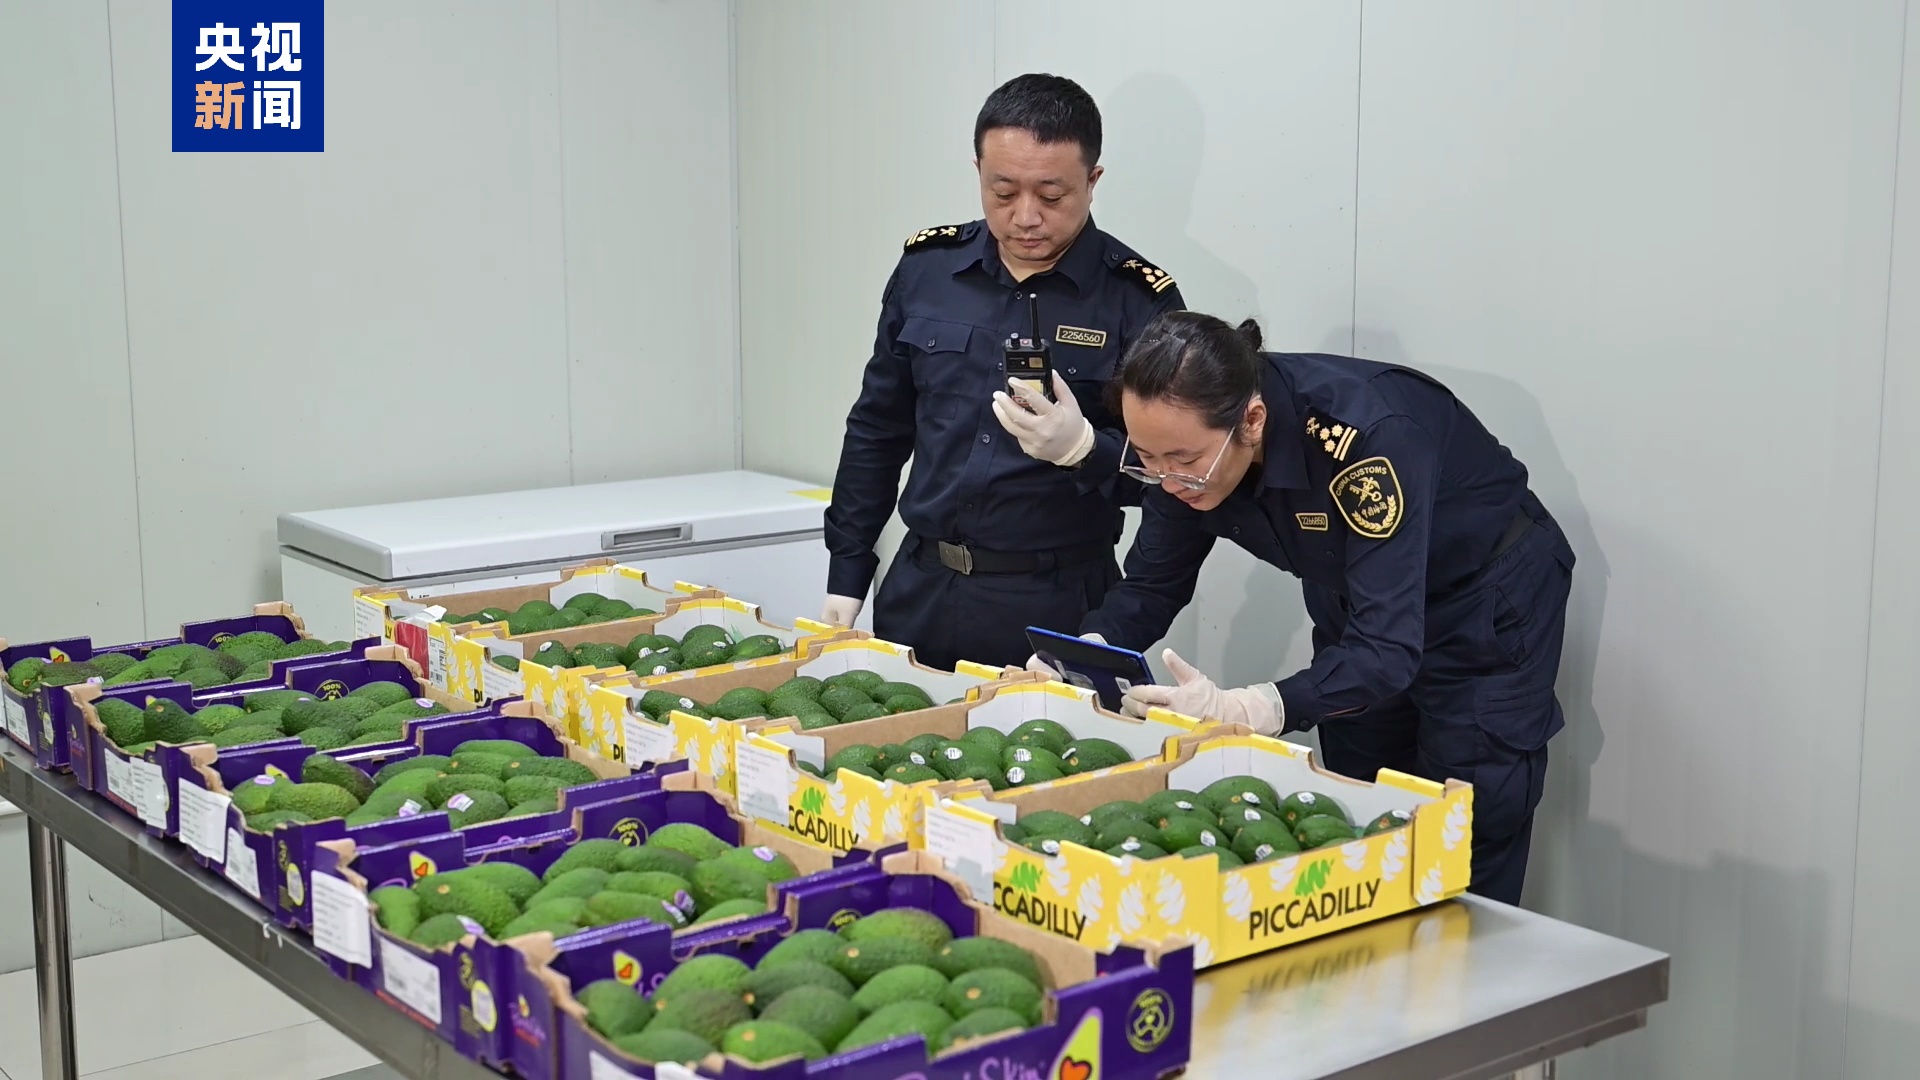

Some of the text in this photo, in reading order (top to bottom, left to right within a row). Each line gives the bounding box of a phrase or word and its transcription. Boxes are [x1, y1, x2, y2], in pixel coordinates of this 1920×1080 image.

[1061, 330, 1101, 343] 2256560
[1335, 465, 1388, 497] CHINA CUSTOMS
[788, 805, 860, 852] CCADILLY
[993, 881, 1087, 941] CCADILLY
[1250, 878, 1381, 941] PICCADILLY
